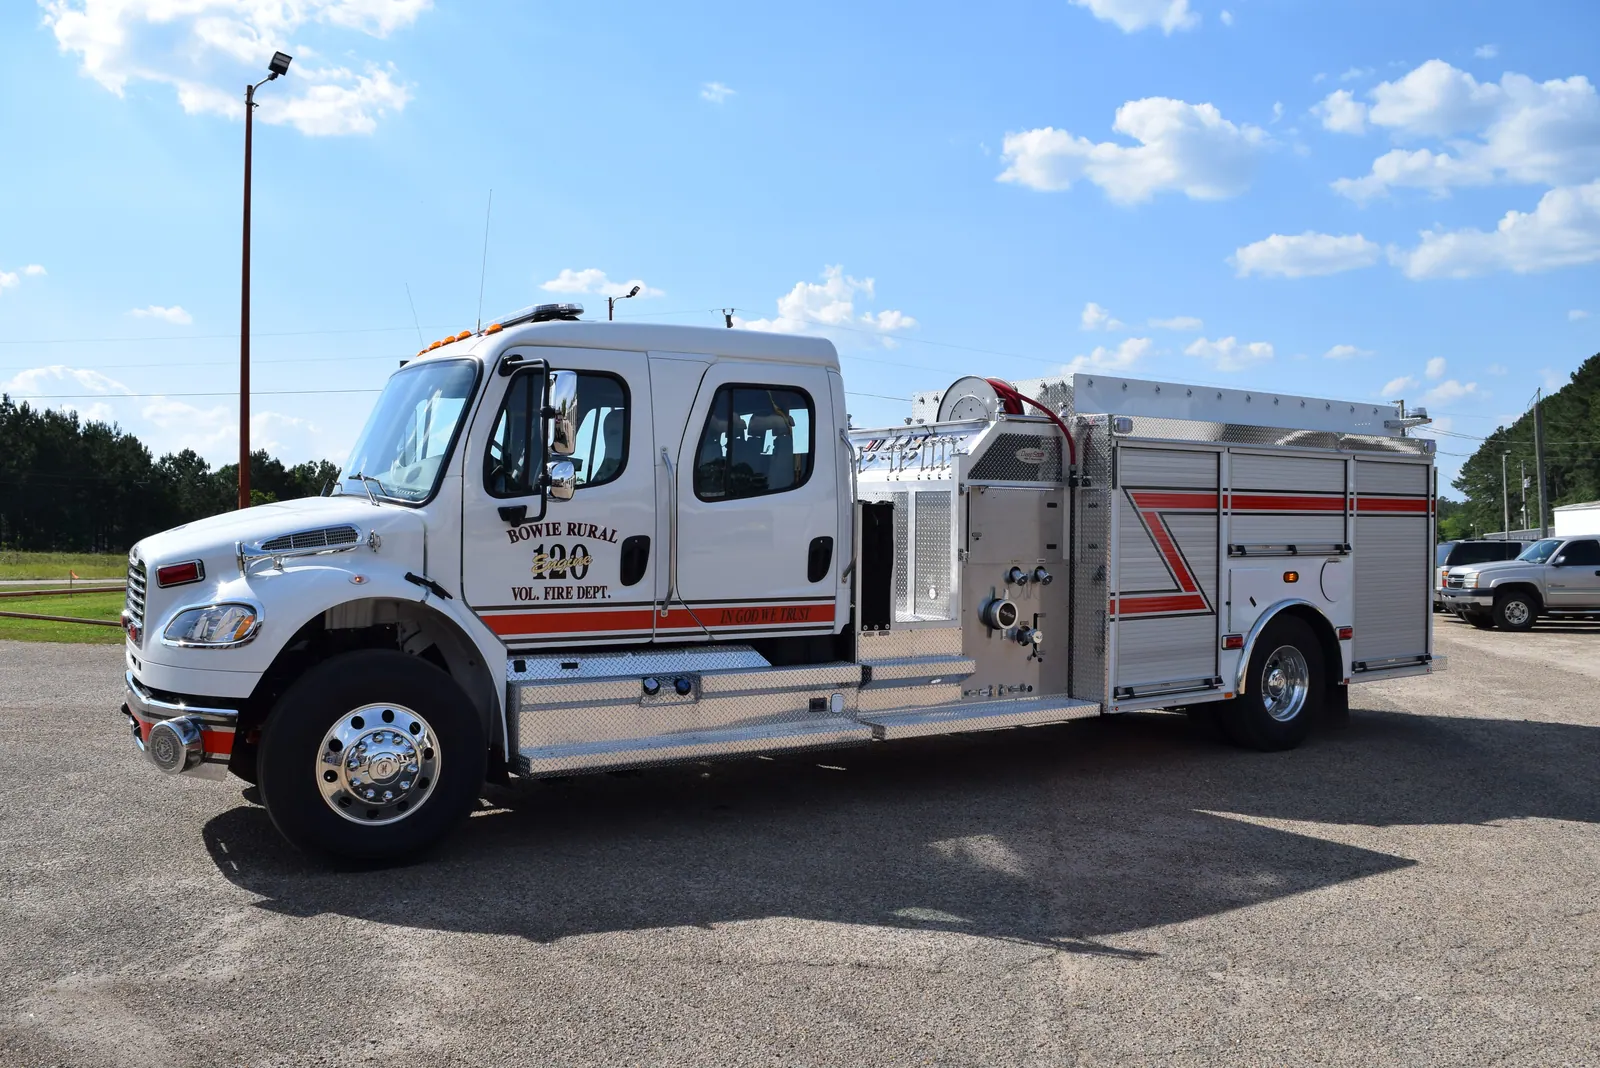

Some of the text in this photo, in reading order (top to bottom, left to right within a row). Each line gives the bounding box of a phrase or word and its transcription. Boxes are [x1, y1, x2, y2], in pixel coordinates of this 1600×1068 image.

[506, 522, 619, 544] BOWIE RURAL
[531, 553, 593, 574] Engine
[532, 543, 589, 580] 120
[511, 585, 611, 601] VOL. FIRE DEPT.
[720, 607, 811, 624] IN GOD WE TRUST
